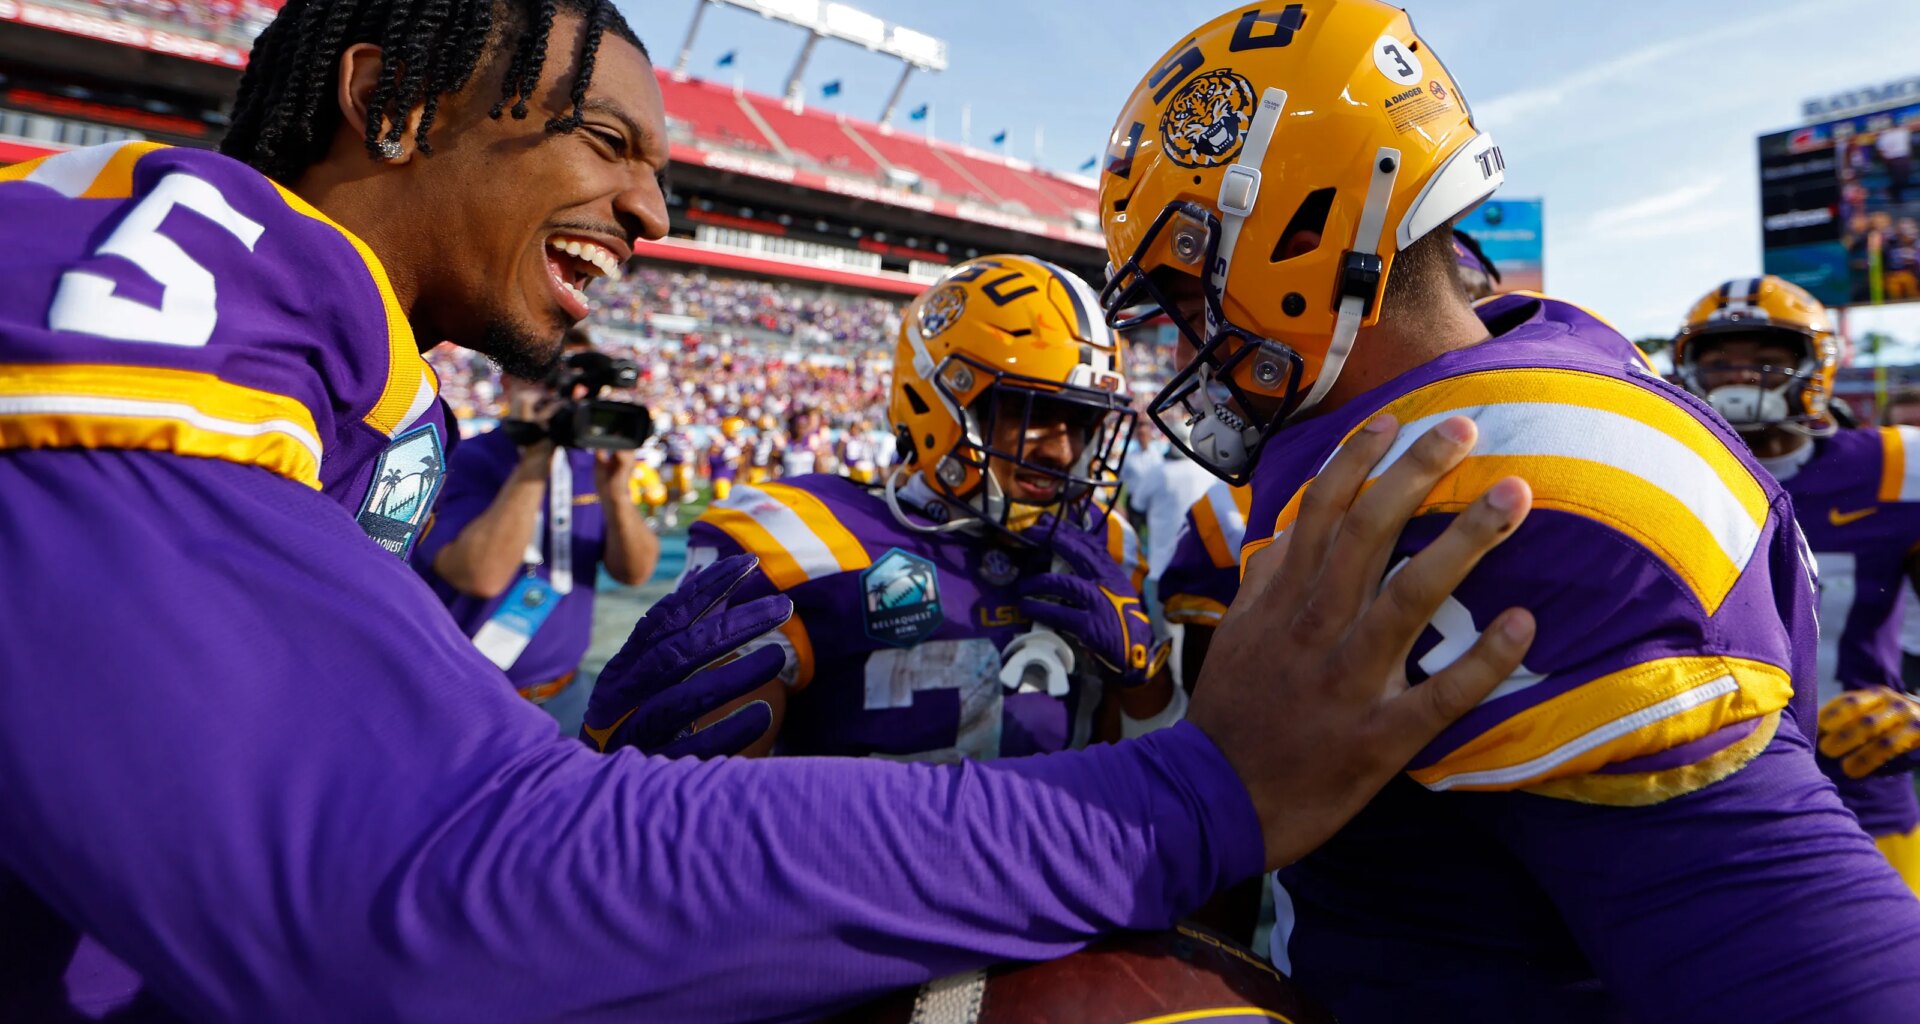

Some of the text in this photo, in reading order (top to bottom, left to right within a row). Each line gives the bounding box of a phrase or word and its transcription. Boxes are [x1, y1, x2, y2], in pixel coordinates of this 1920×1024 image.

[1383, 43, 1414, 77] 3
[1391, 87, 1424, 104] DANGER
[48, 173, 265, 347] 5
[872, 611, 932, 630] RELIAQUEST
[895, 624, 918, 635] BOWL
